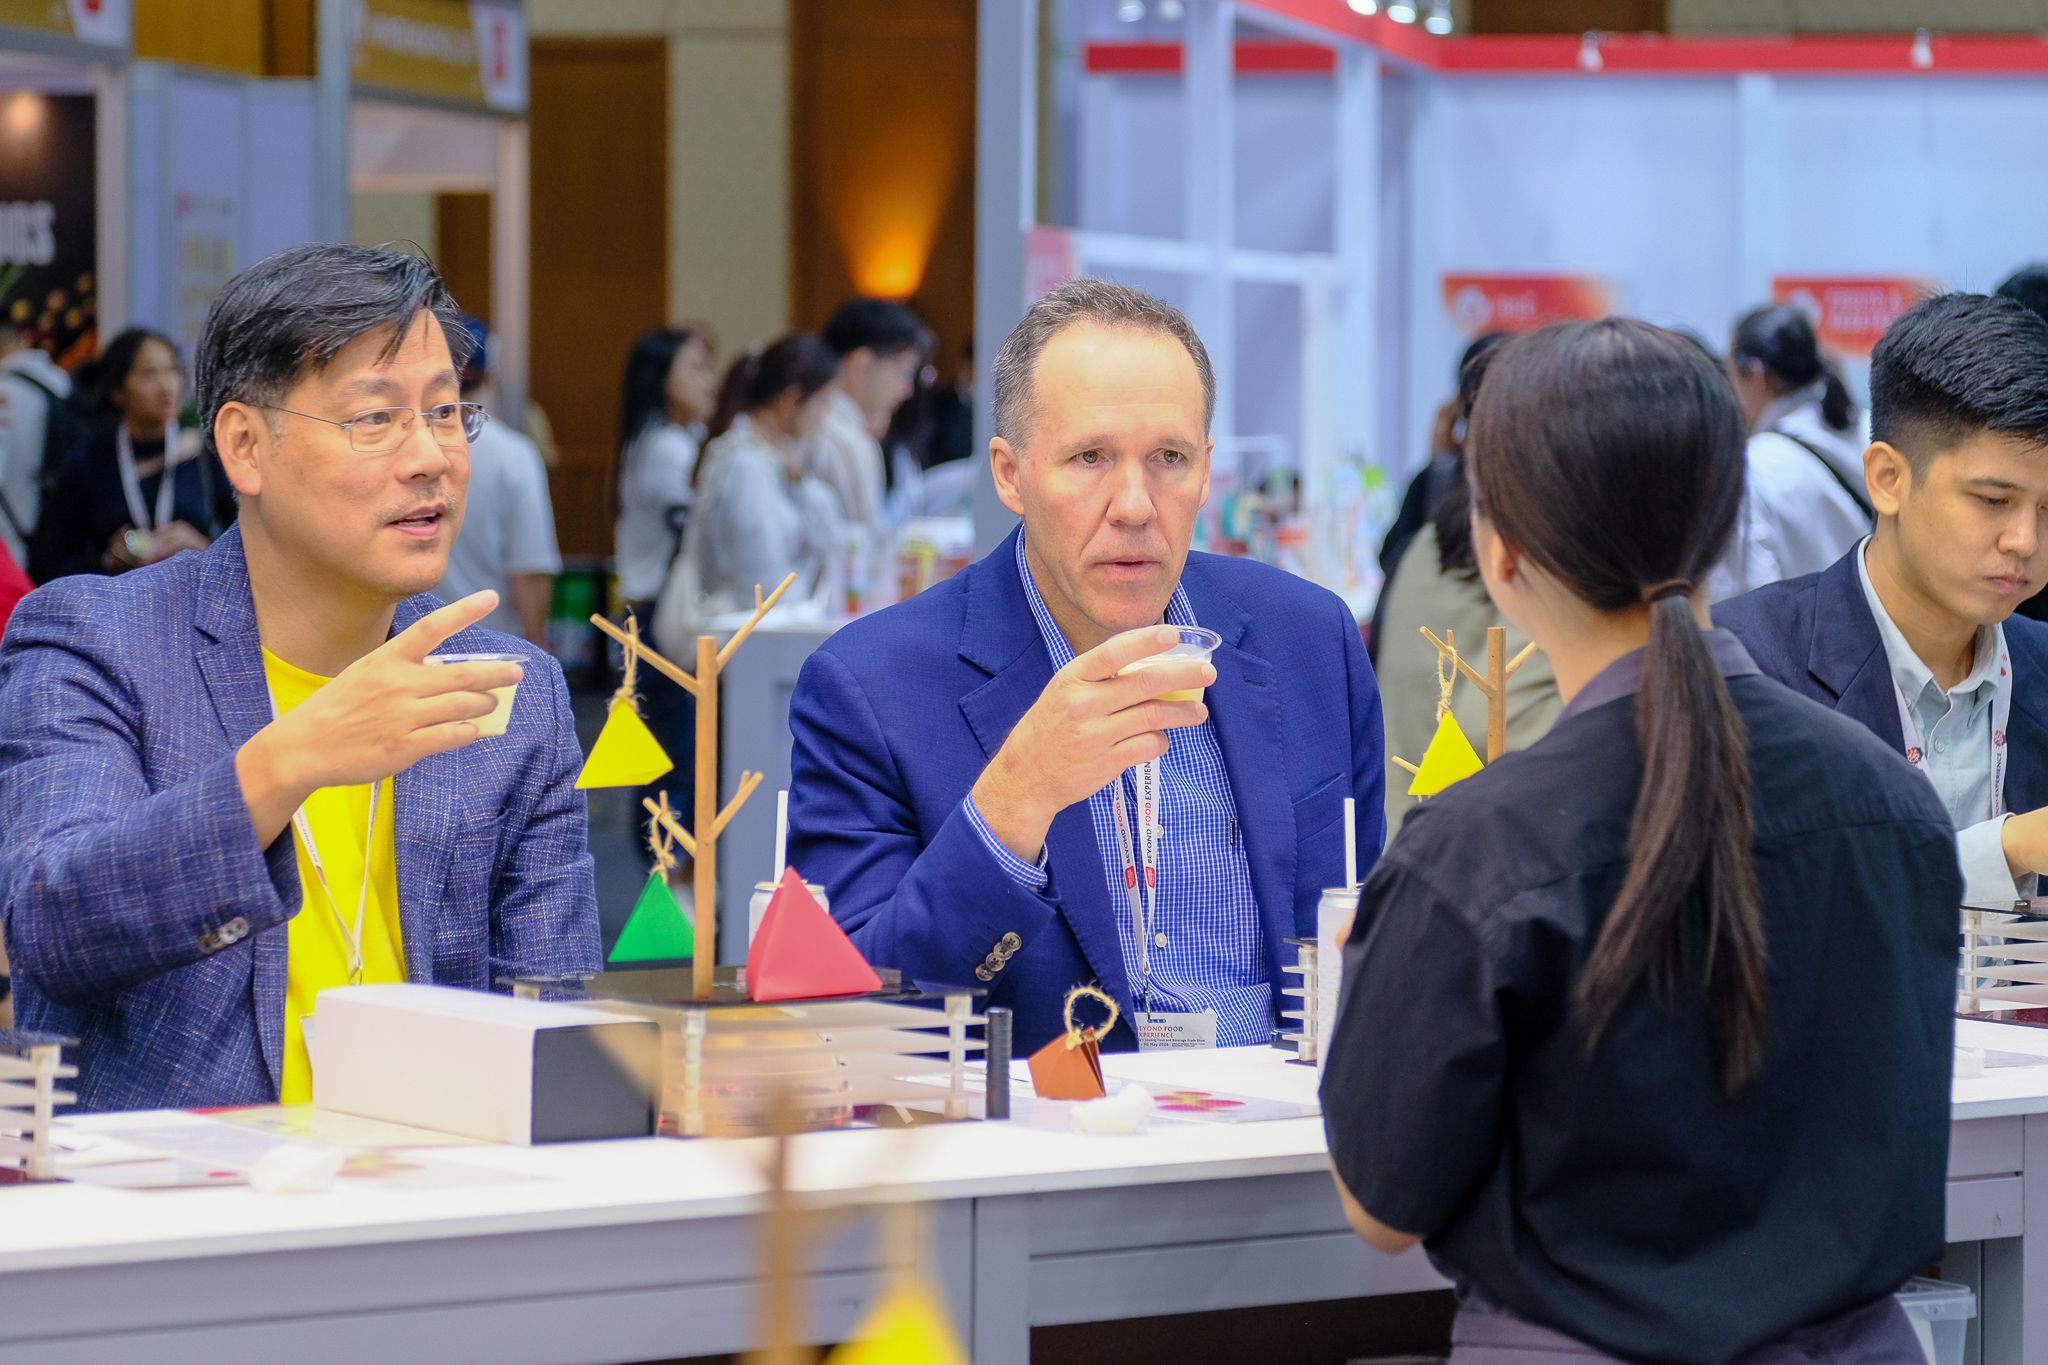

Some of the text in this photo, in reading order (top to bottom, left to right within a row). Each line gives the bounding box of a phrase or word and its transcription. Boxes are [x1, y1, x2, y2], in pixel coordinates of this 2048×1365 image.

[1144, 761, 1152, 800] EXPERIEN
[1115, 802, 1124, 827] FOOD
[1144, 802, 1152, 827] FOOD
[1120, 829, 1131, 864] BEYOND
[1145, 829, 1153, 864] BEYOND
